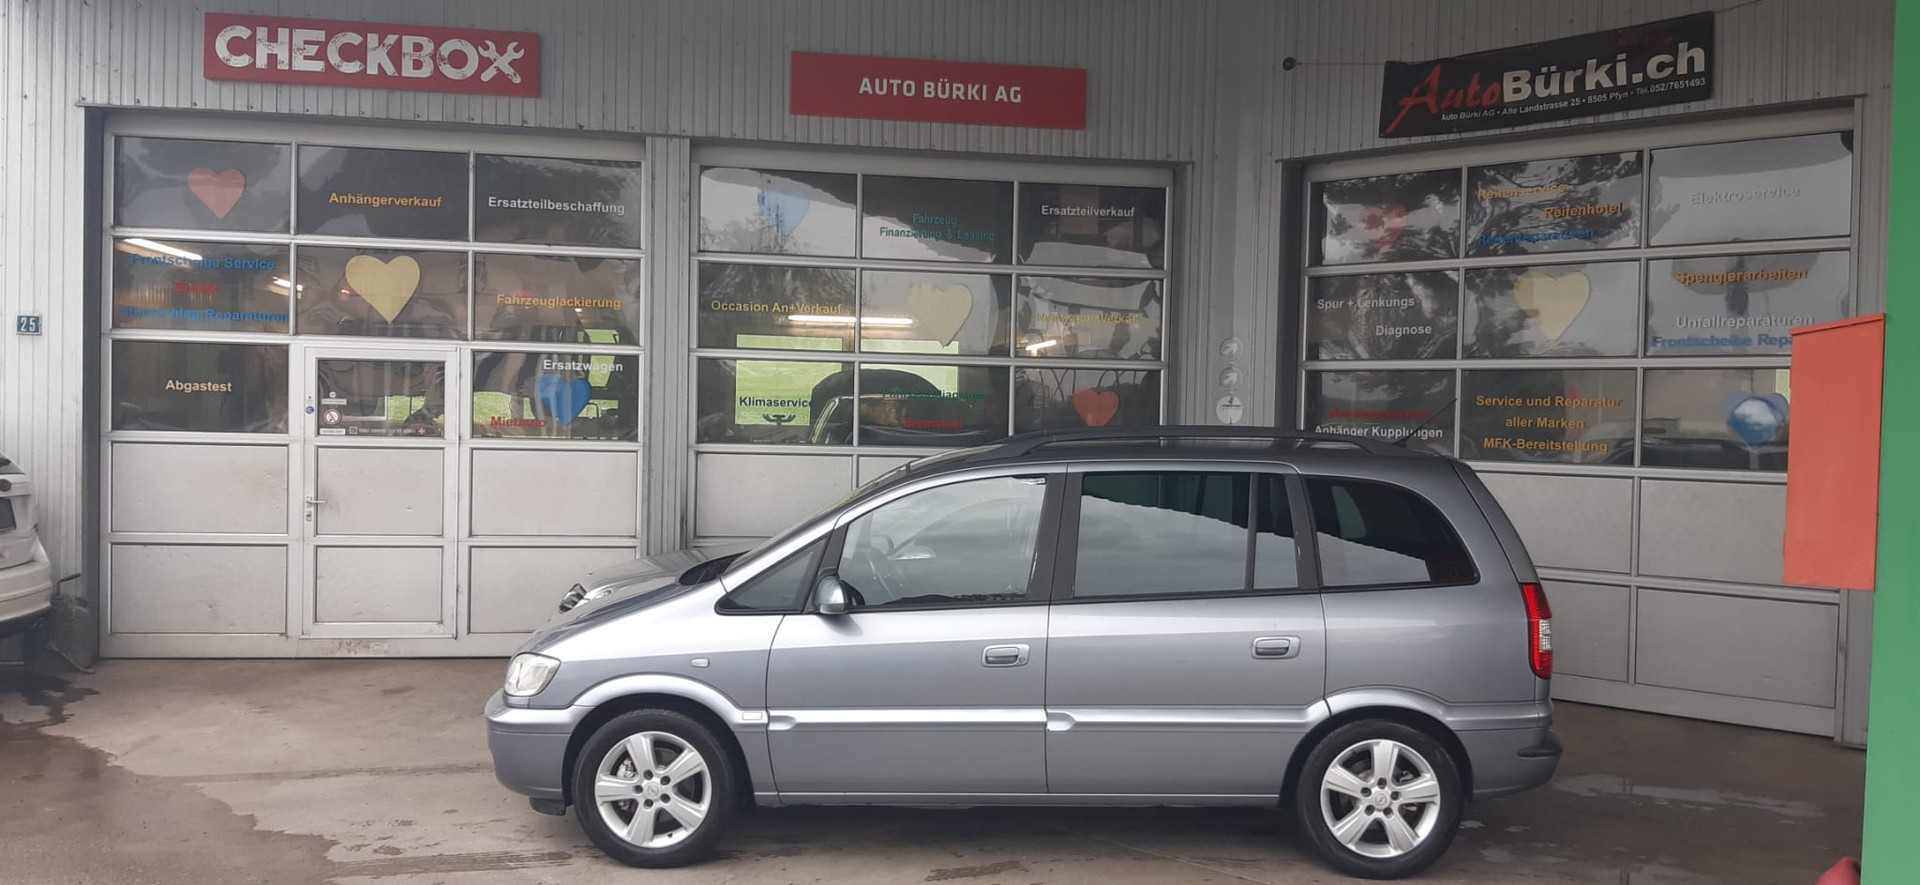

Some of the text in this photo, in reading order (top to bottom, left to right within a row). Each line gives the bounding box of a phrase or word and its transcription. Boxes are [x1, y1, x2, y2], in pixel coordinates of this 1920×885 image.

[859, 77, 1022, 103] AUTO BÜRKI AG
[1441, 112, 1458, 122] Auto
[1482, 109, 1496, 118] AG
[1519, 100, 1569, 114] Landstrasse
[1570, 97, 1581, 107] 25
[1587, 94, 1608, 104] 8505
[1609, 91, 1629, 102] Pfyn
[328, 192, 443, 209] Anhängerverkauf
[1690, 185, 1801, 205] Elektroservice
[488, 196, 626, 215] Ersatzteilbeschaffung
[1041, 204, 1136, 218] Ersatzteilverkauf
[1544, 201, 1623, 219] Reifenhotel
[912, 213, 958, 228] Fahrzeug
[224, 256, 277, 270] Service
[1675, 267, 1808, 285] Spenglerarbeiten
[496, 294, 622, 311] Fahrzeuglackierung
[711, 300, 842, 314] Occasion An+Verkauf
[1316, 298, 1344, 312] Spur
[1357, 297, 1415, 311] Lenkungs
[20, 317, 36, 332] 25
[1676, 314, 1815, 330] Unfallreparaturen
[1376, 324, 1432, 338] Diagnose
[543, 360, 624, 374] Ersatzwagen
[164, 379, 233, 393] Abgastest
[1476, 395, 1622, 409] Service und Reparatur
[1505, 416, 1585, 430] aller Marken
[1483, 437, 1608, 454] MFK-Bereitstellung
